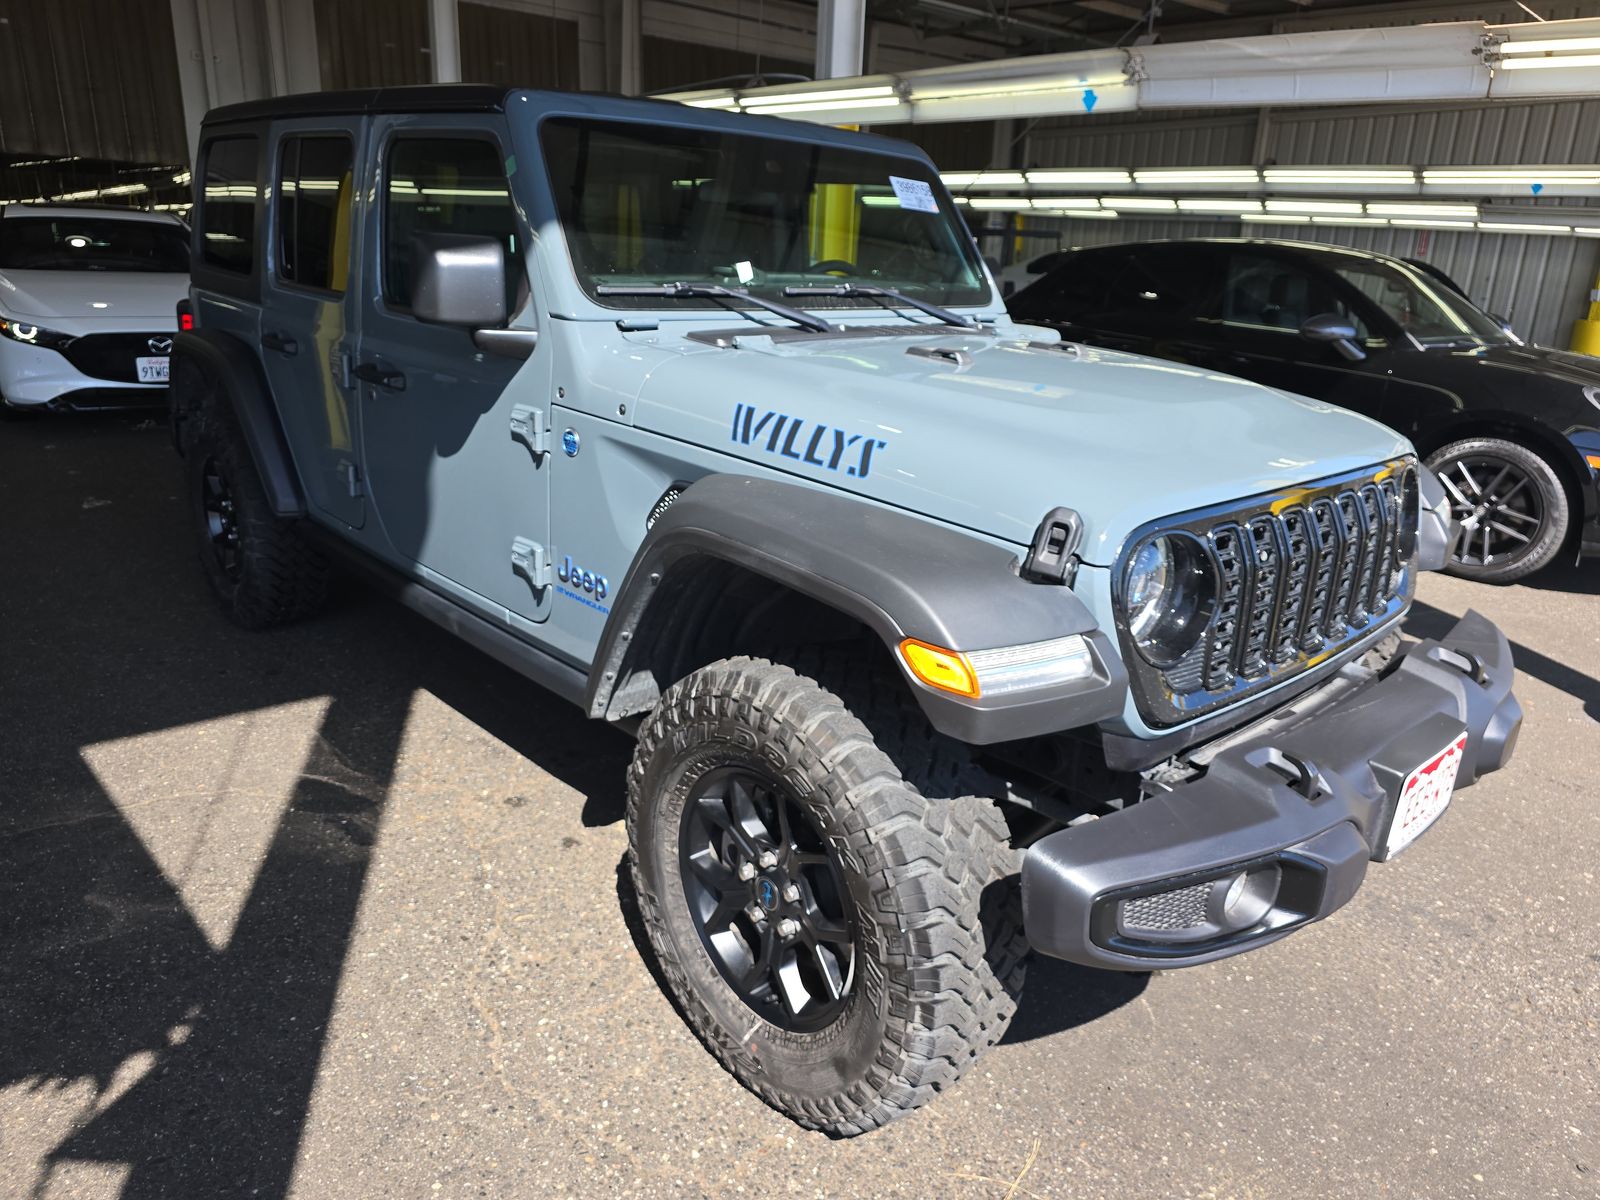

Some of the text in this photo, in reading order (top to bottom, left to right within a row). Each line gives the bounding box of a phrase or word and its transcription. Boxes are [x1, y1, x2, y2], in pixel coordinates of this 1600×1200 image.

[142, 366, 169, 378] 9TWG
[731, 402, 888, 479] WILLYS
[557, 554, 609, 601] Jeep
[672, 720, 862, 875] WILDPEAK
